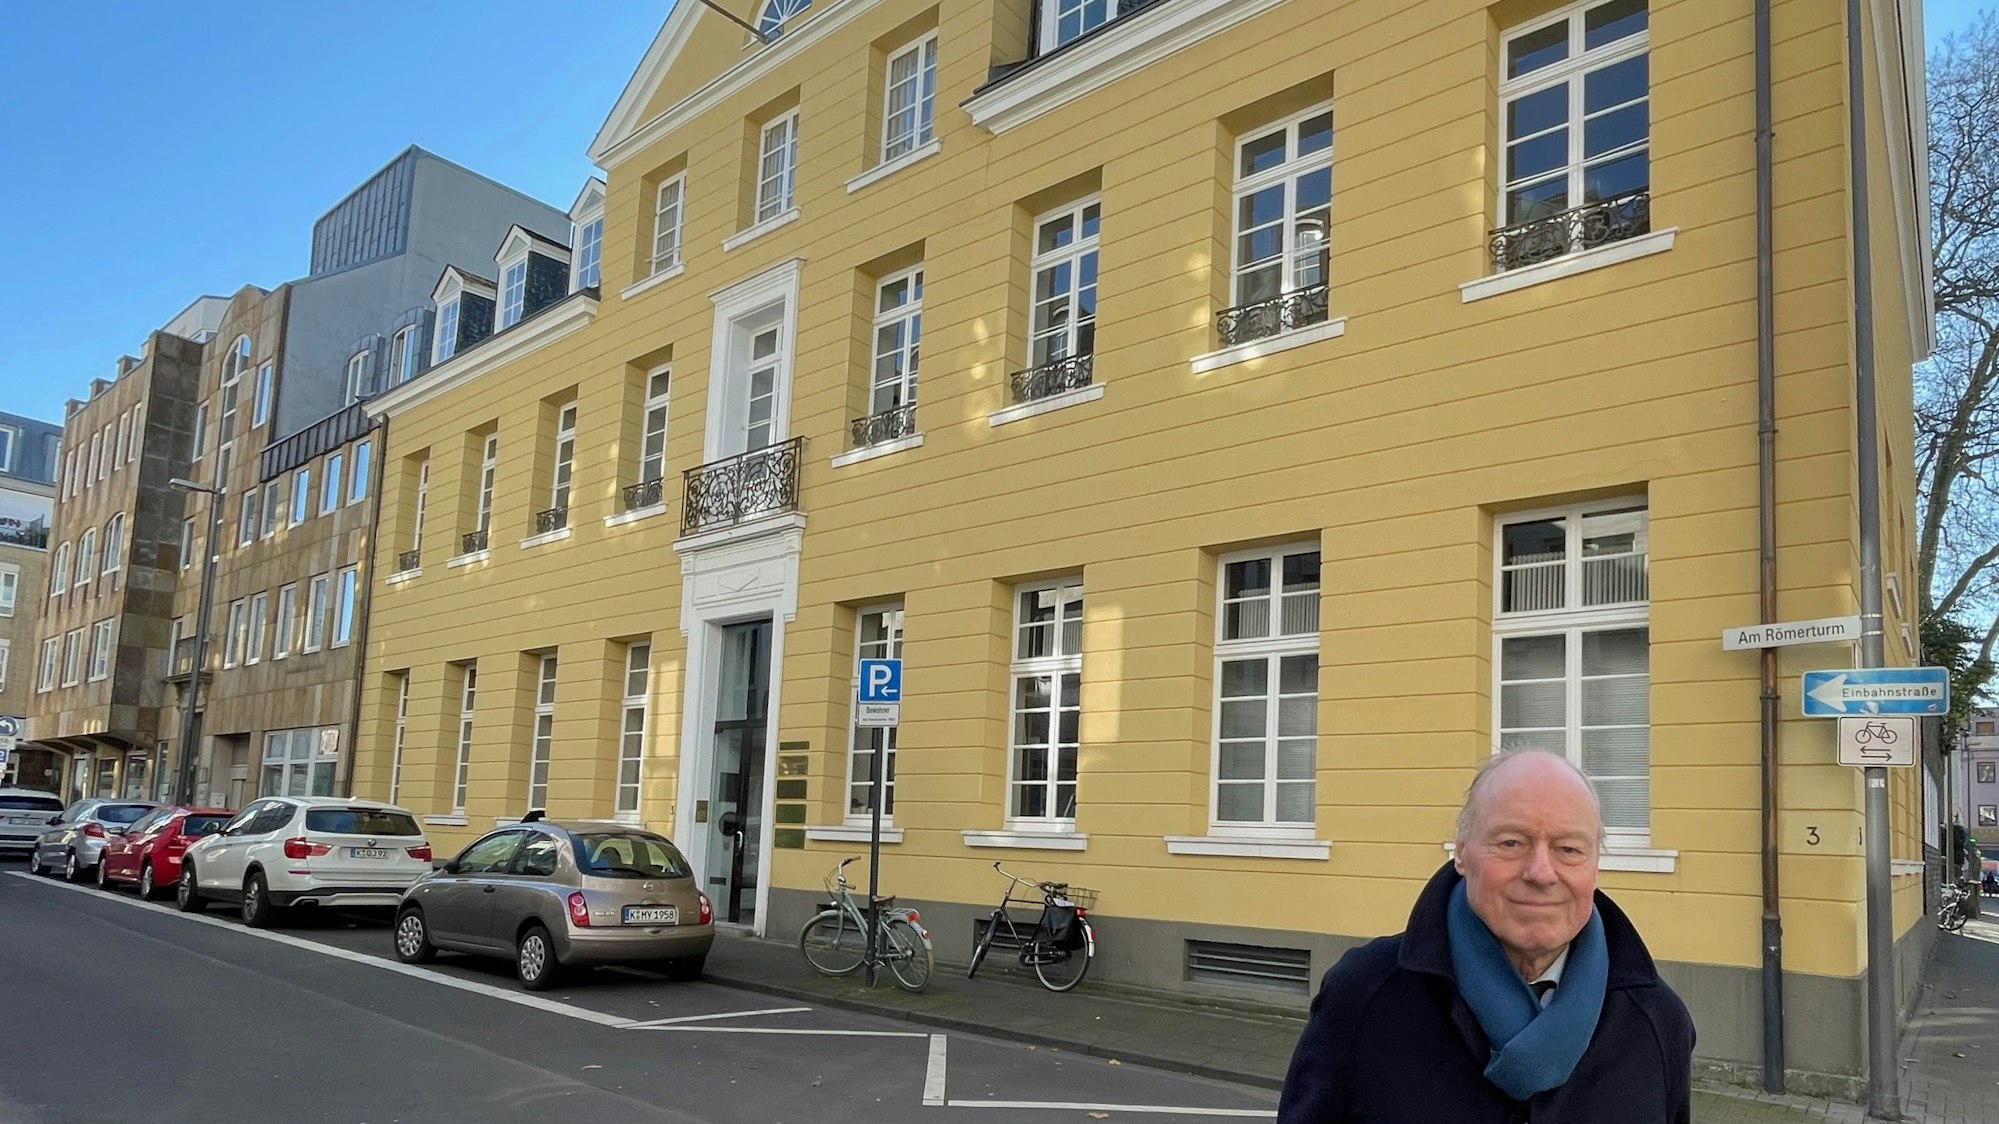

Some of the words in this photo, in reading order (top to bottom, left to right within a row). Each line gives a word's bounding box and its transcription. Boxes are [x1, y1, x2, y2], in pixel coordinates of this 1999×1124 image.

[1738, 631, 1760, 644] Am
[1766, 624, 1845, 641] Römerturm
[868, 664, 892, 697] P
[1842, 686, 1937, 698] Einbahnstraße
[866, 706, 890, 714] Bewohner
[1806, 826, 1820, 846] 3
[630, 911, 635, 920] K
[641, 910, 653, 920] MY
[654, 910, 674, 920] 1958
